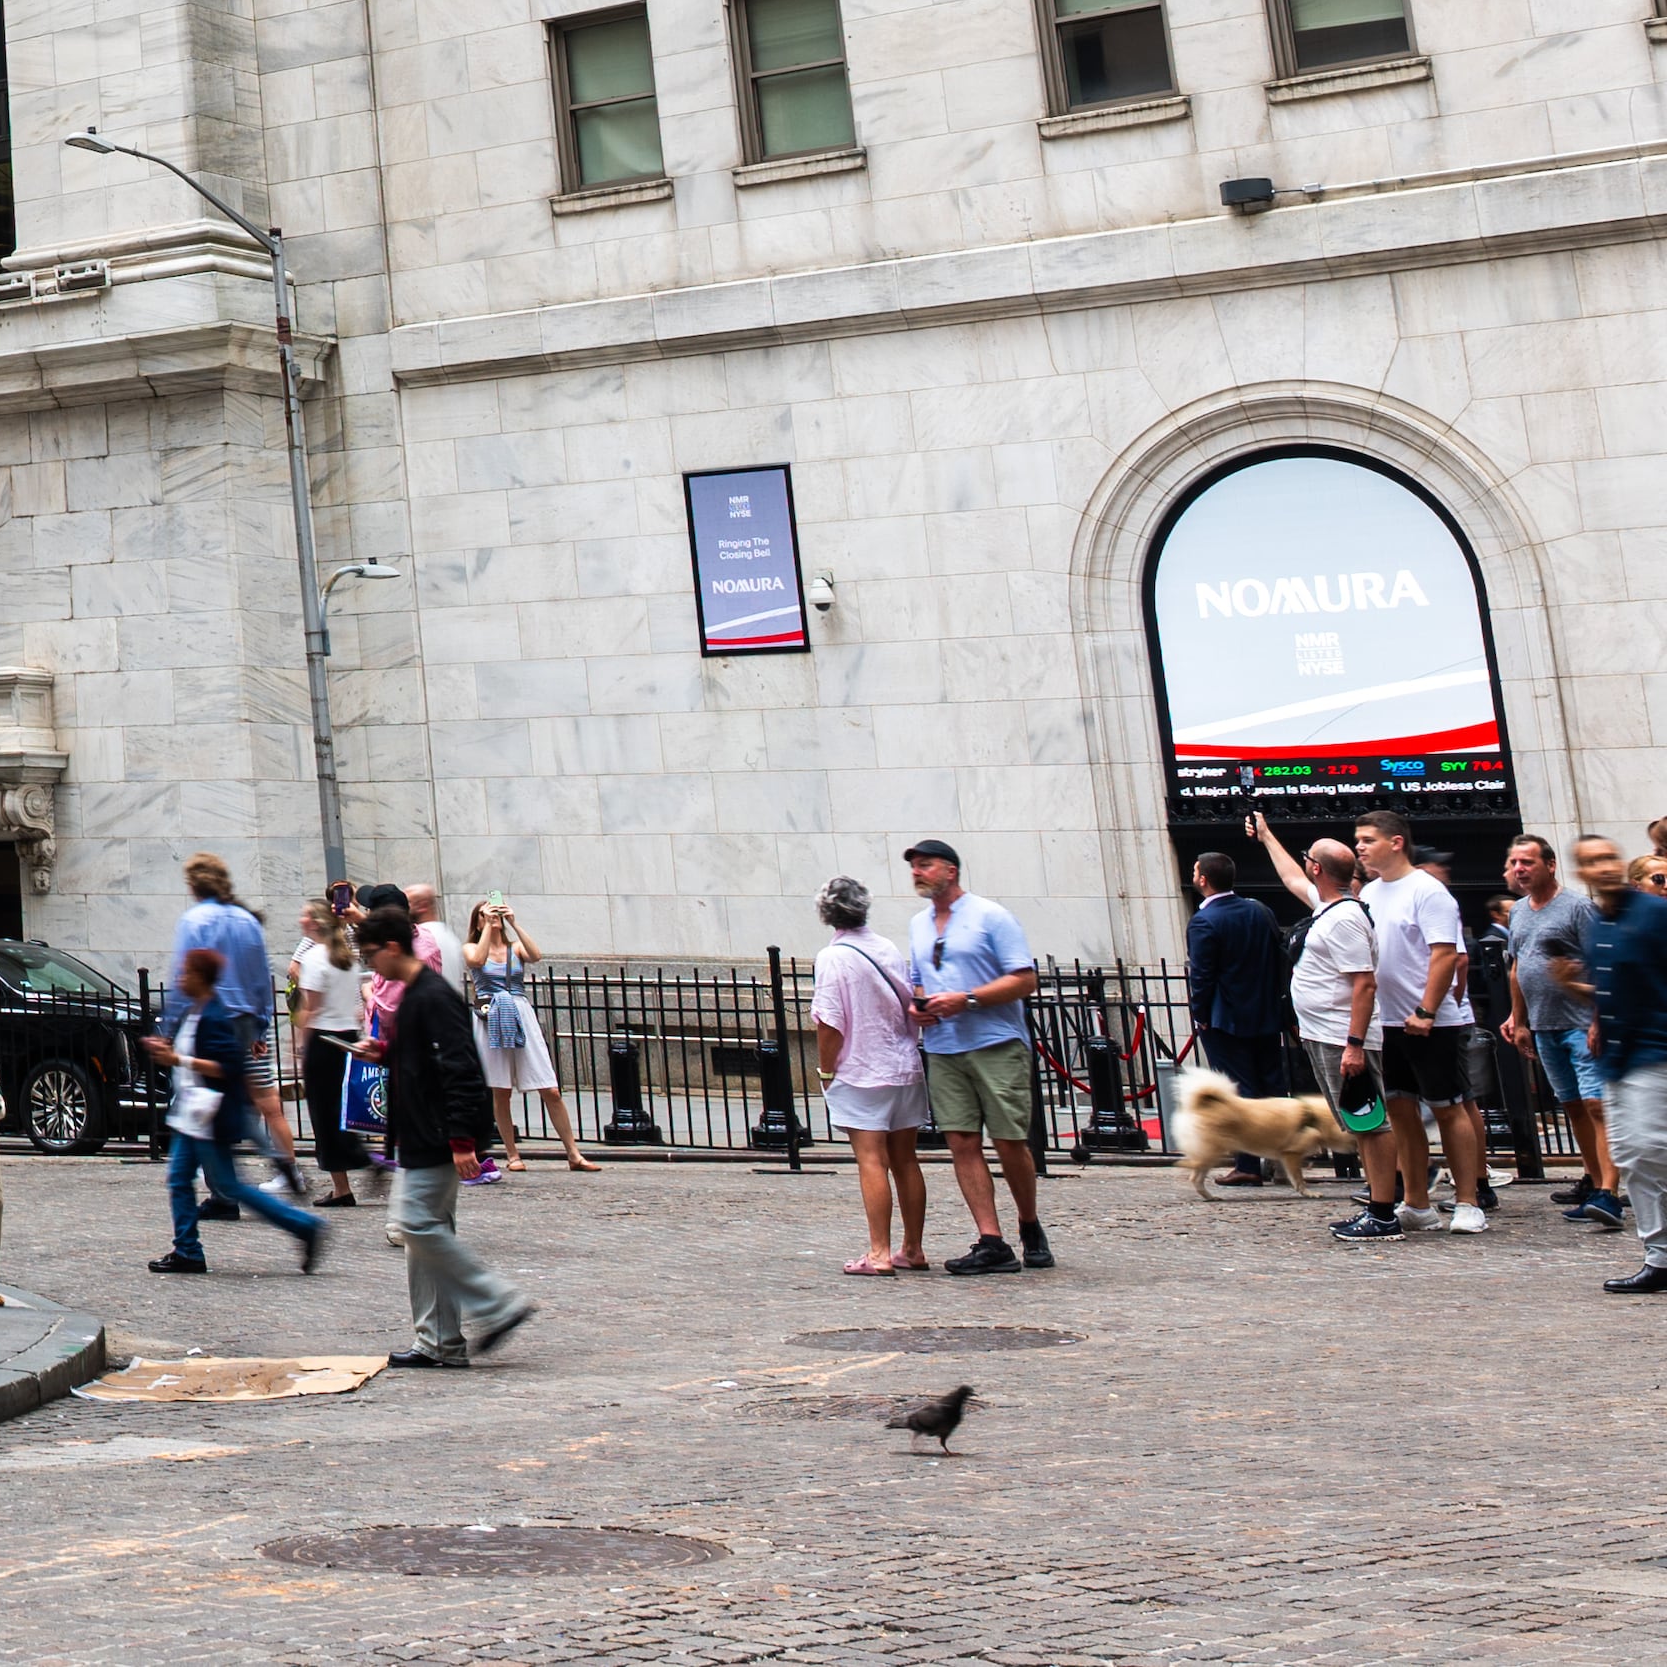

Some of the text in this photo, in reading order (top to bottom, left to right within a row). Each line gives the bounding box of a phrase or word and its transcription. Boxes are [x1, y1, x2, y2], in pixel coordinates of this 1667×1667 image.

[729, 496, 749, 504] NMR
[729, 510, 751, 518] NYSE
[718, 537, 769, 549] Ringing The
[719, 548, 771, 560] Closing Bell
[712, 576, 785, 594] NOMURA
[1195, 569, 1430, 619] NOMURA
[1294, 632, 1340, 648] NMR
[1296, 649, 1342, 659] LISTED
[1298, 660, 1345, 676] NYSE
[1177, 767, 1227, 778] stryker
[1263, 765, 1312, 776] 282.03
[1328, 764, 1359, 775] 2.73
[1380, 759, 1425, 772] Sysco
[1440, 761, 1467, 771] SYY
[1195, 786, 1229, 796] Major
[1287, 785, 1299, 794] Is
[1300, 784, 1336, 795] Being
[1400, 782, 1422, 792] US
[1422, 781, 1474, 792] Jobless
